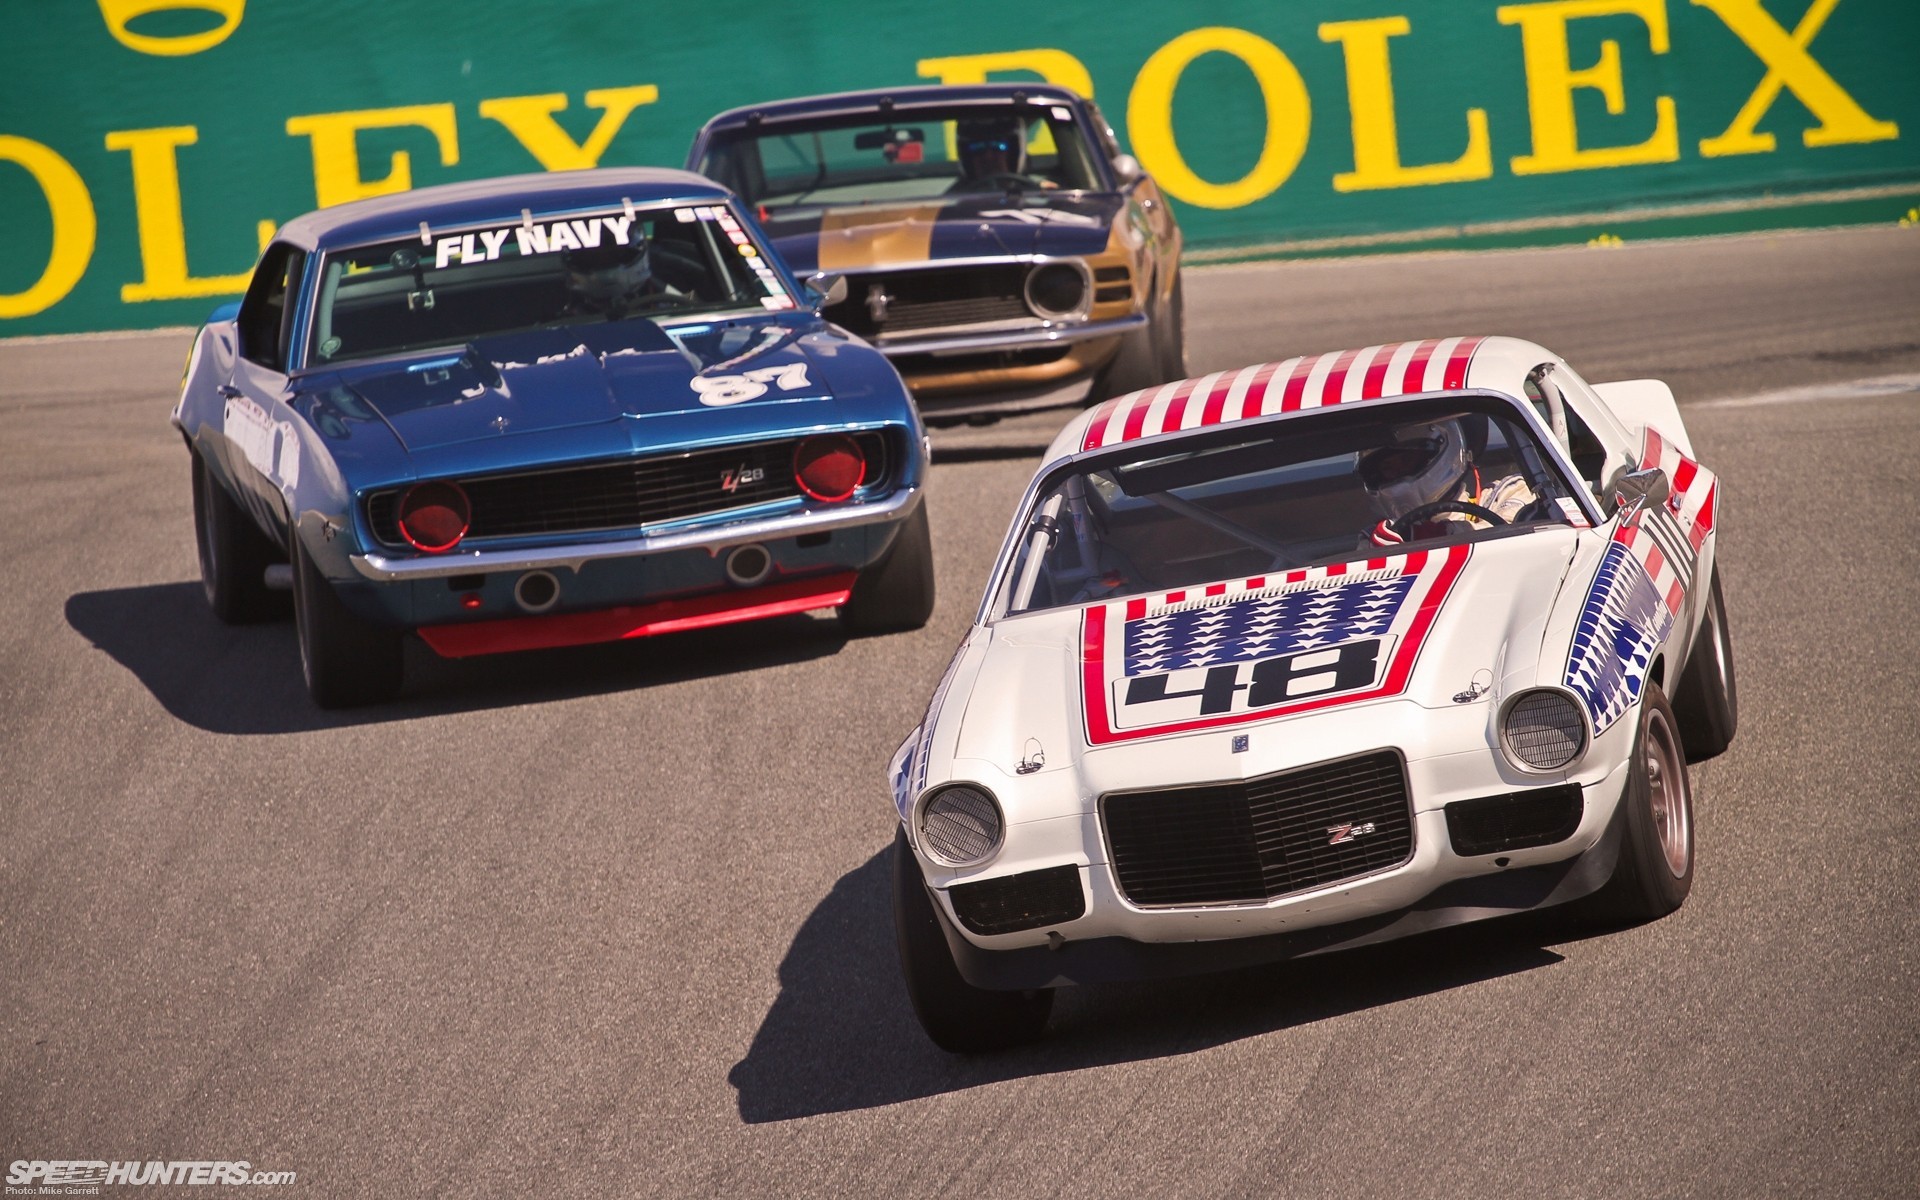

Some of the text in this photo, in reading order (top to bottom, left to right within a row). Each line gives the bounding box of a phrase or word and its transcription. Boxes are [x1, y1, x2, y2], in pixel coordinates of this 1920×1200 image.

[435, 216, 631, 269] FLY NAVY
[689, 362, 812, 407] 87
[1124, 638, 1382, 716] 48
